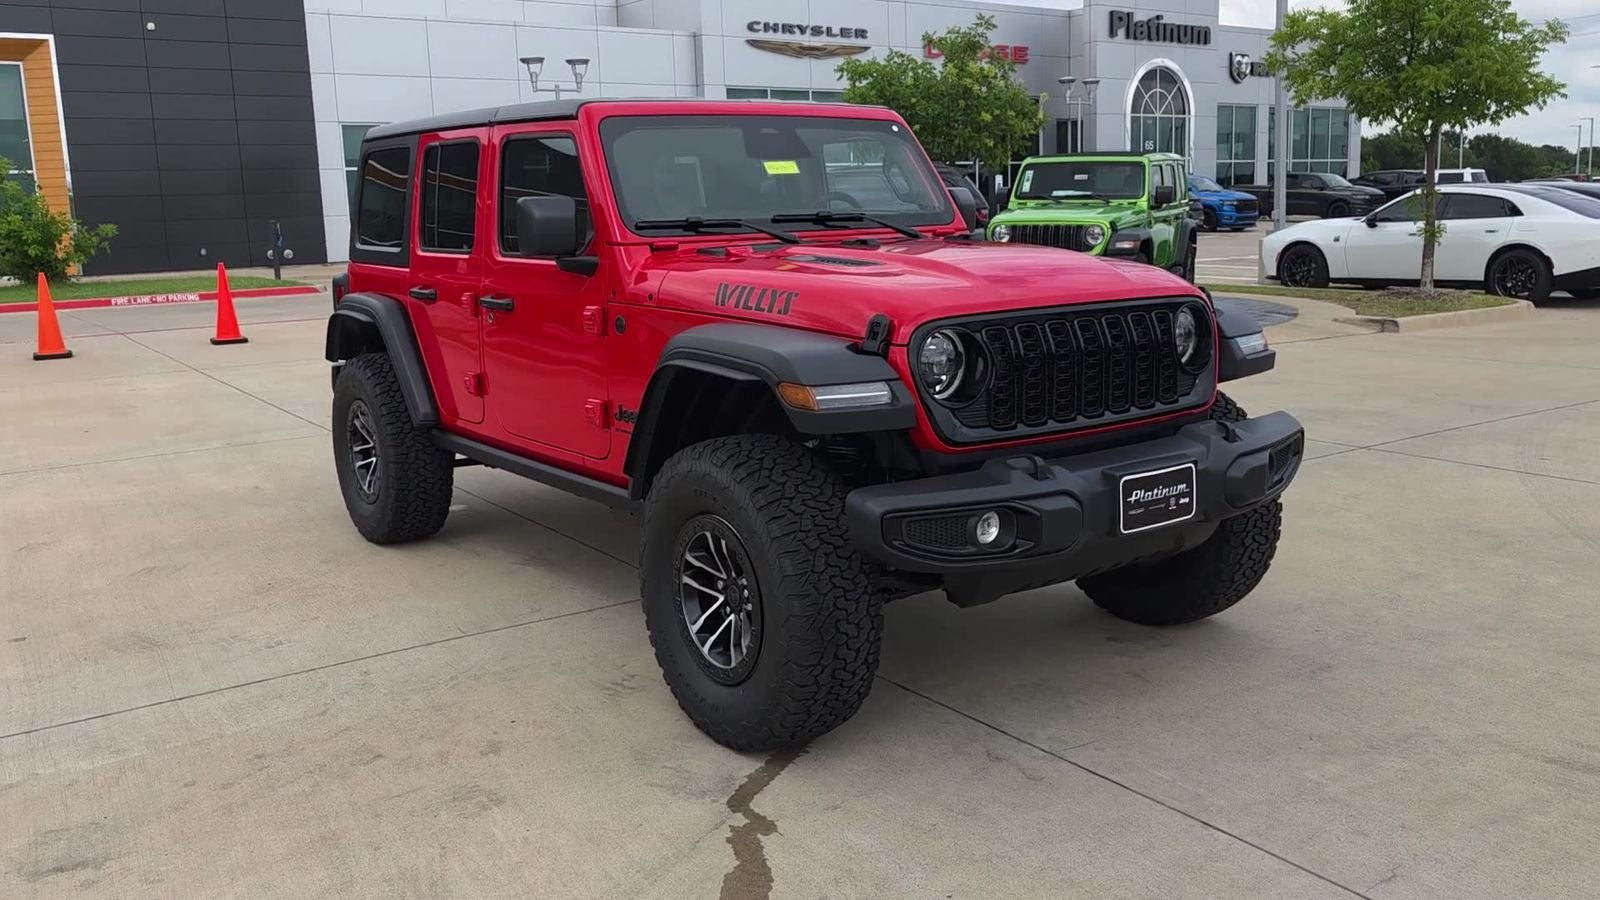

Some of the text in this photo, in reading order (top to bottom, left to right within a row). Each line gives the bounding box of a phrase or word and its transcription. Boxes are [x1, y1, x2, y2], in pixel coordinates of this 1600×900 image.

[747, 21, 868, 39] CHRYSLER
[1109, 10, 1211, 45] Platinum
[1144, 140, 1154, 150] 65
[111, 292, 199, 306] FIRE LANE NO PARKING
[715, 282, 799, 315] WILLYS
[1126, 483, 1190, 504] Platinum
